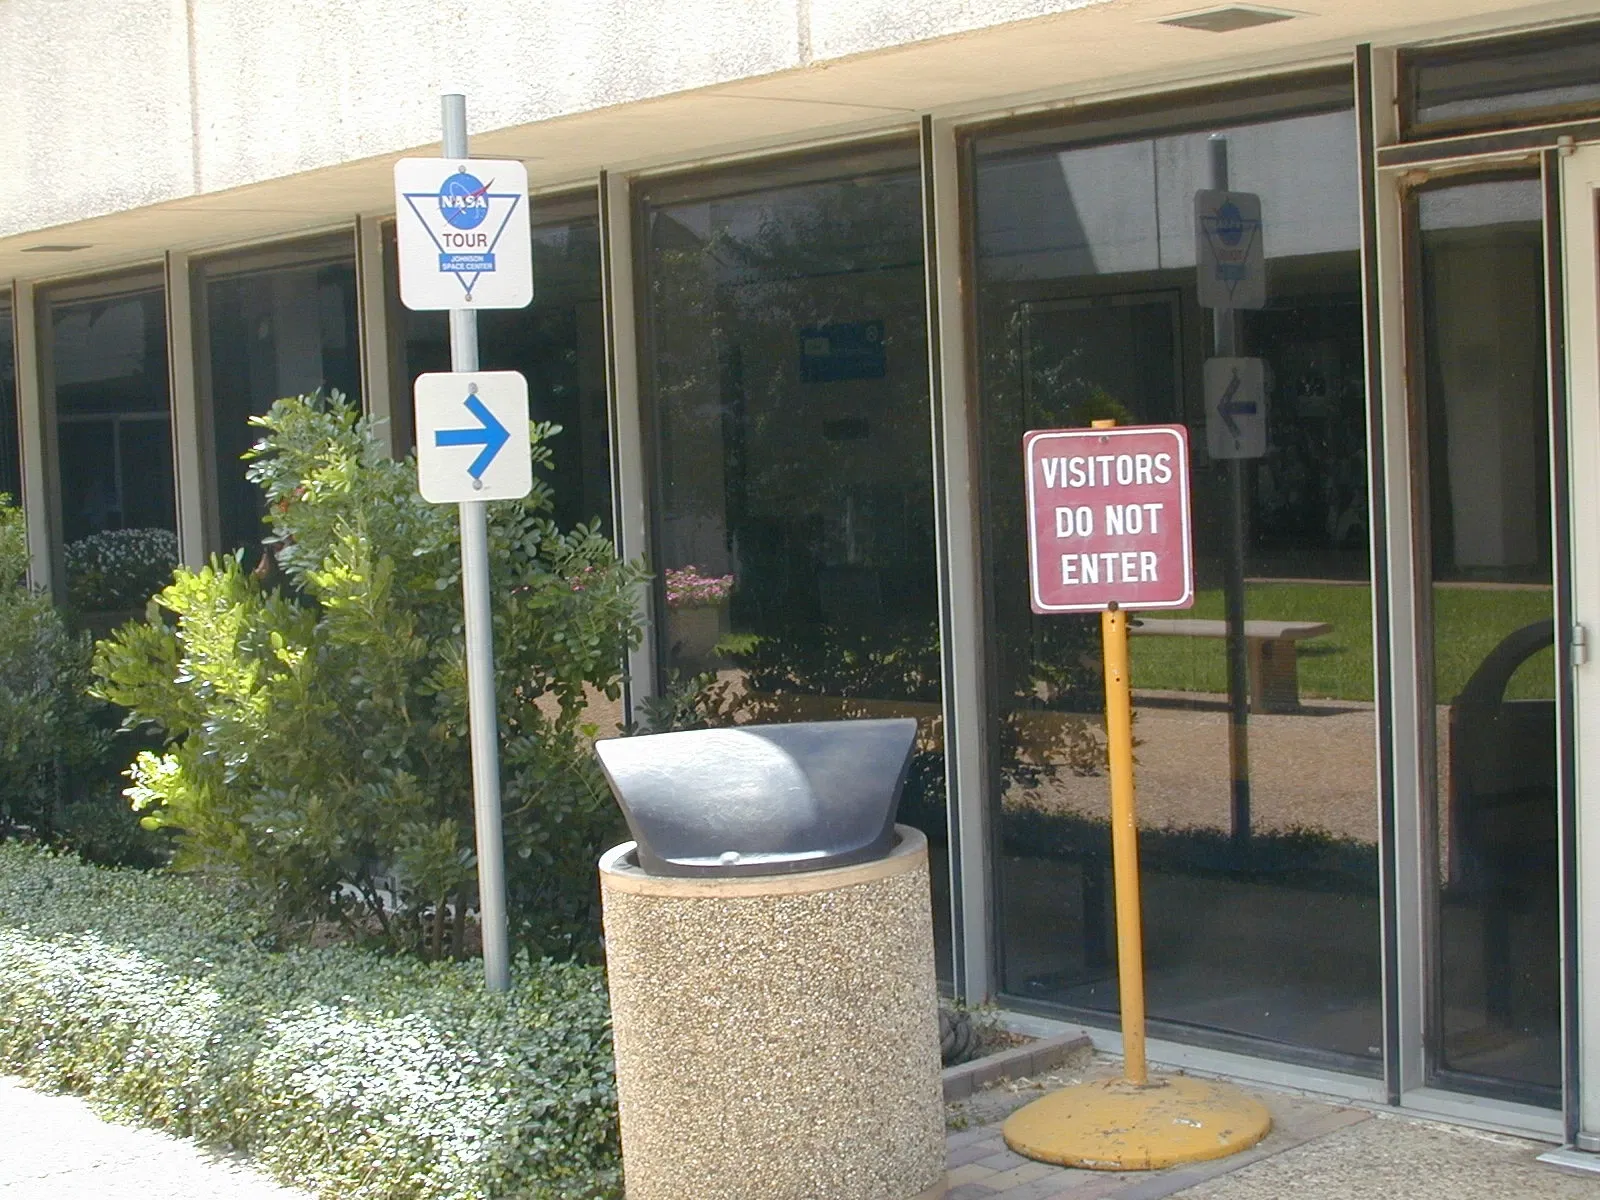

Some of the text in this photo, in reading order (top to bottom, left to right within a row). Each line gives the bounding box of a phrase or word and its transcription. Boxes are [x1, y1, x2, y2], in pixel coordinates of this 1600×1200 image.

[442, 195, 487, 208] NASA
[442, 233, 488, 247] TOUR
[442, 262, 493, 270] SPACE CENTER
[451, 255, 484, 263] JOHNSON
[1041, 453, 1172, 488] VISITORS
[1055, 503, 1164, 538] DO NOT
[1061, 551, 1158, 585] ENTER
